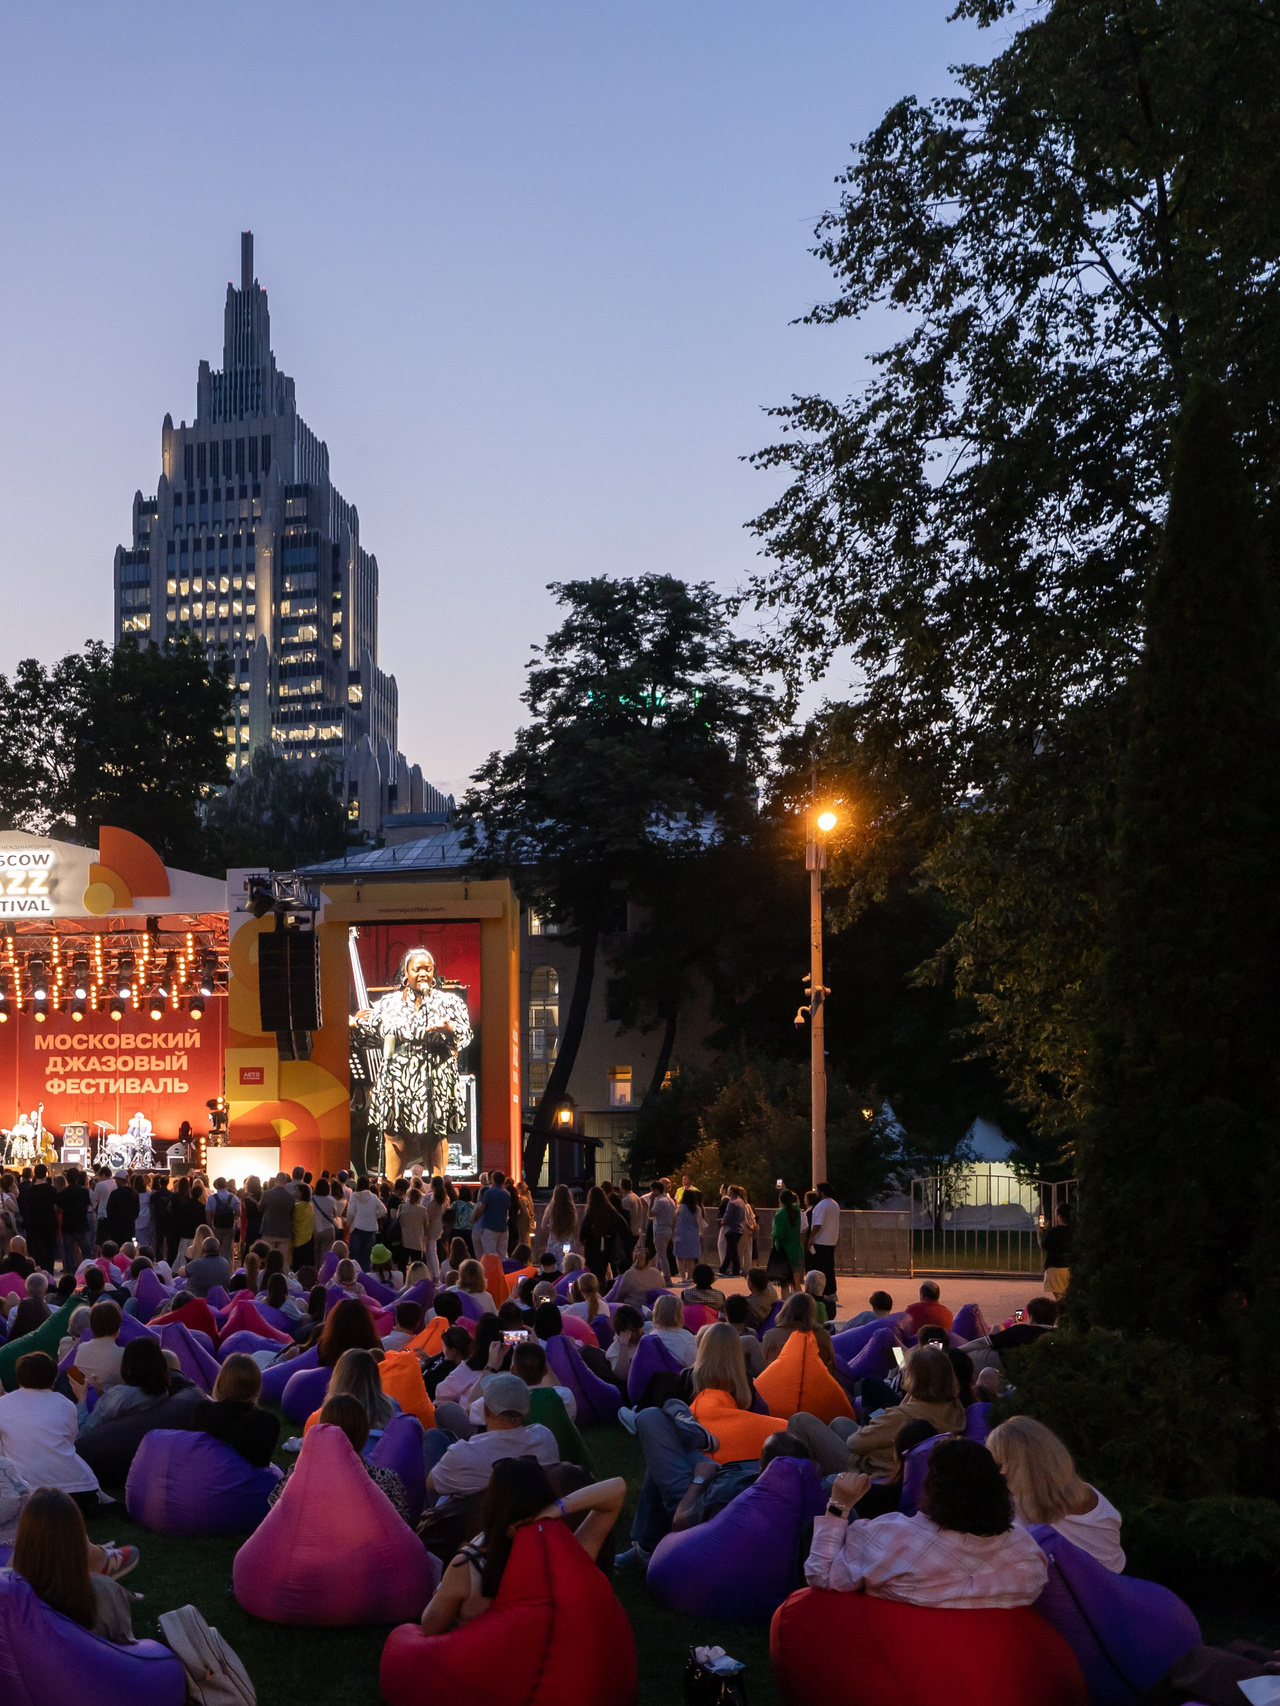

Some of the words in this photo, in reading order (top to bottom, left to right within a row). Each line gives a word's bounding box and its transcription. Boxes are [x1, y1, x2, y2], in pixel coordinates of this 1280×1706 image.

[34, 1028, 201, 1050] МОСКОВСКИЙ
[45, 1051, 188, 1075] ДЖАЗОВЫЙ
[45, 1078, 189, 1094] ФЕСТИВАЛЬ
